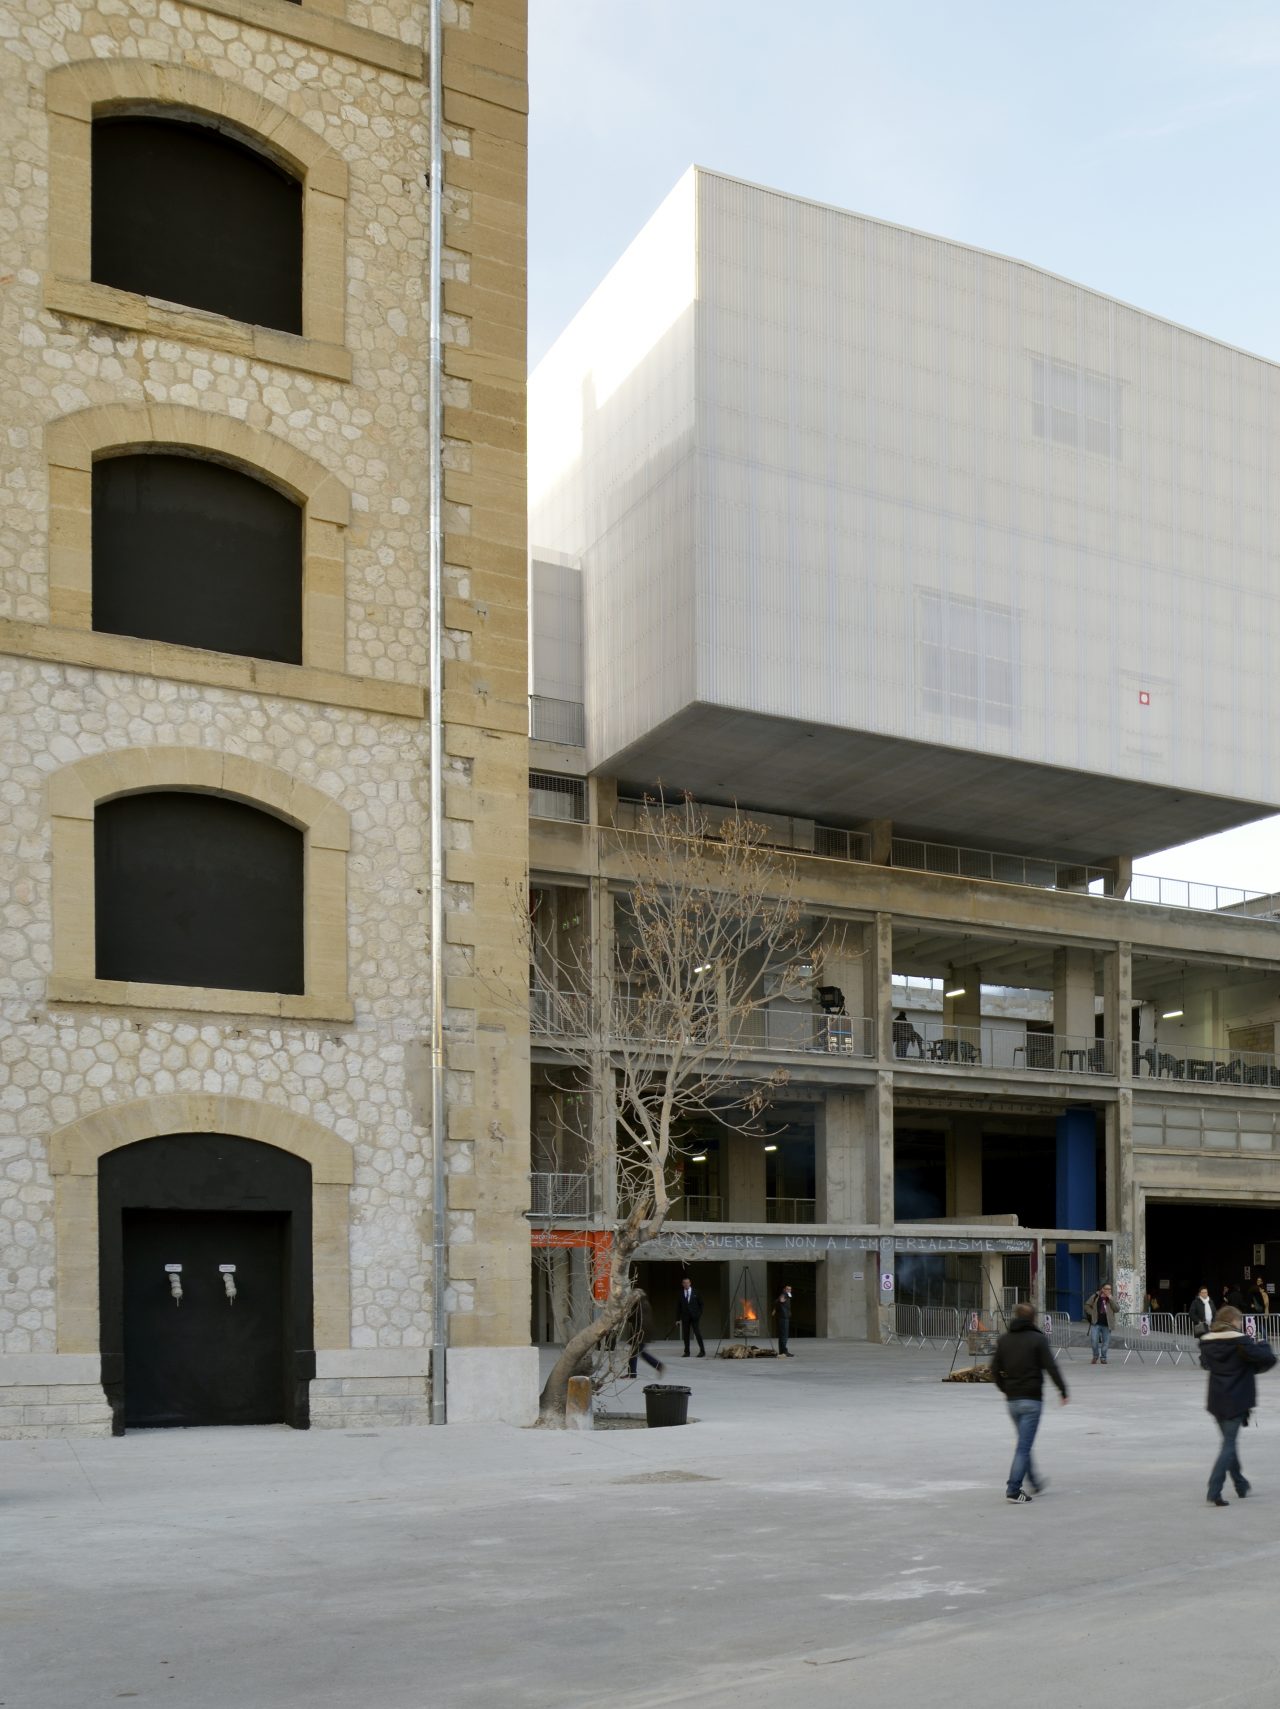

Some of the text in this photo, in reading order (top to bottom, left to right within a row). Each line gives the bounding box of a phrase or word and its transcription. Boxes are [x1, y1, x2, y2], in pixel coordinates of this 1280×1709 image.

[705, 1236, 764, 1249] GUERRE
[785, 1237, 817, 1249] NON
[826, 1237, 837, 1249] A
